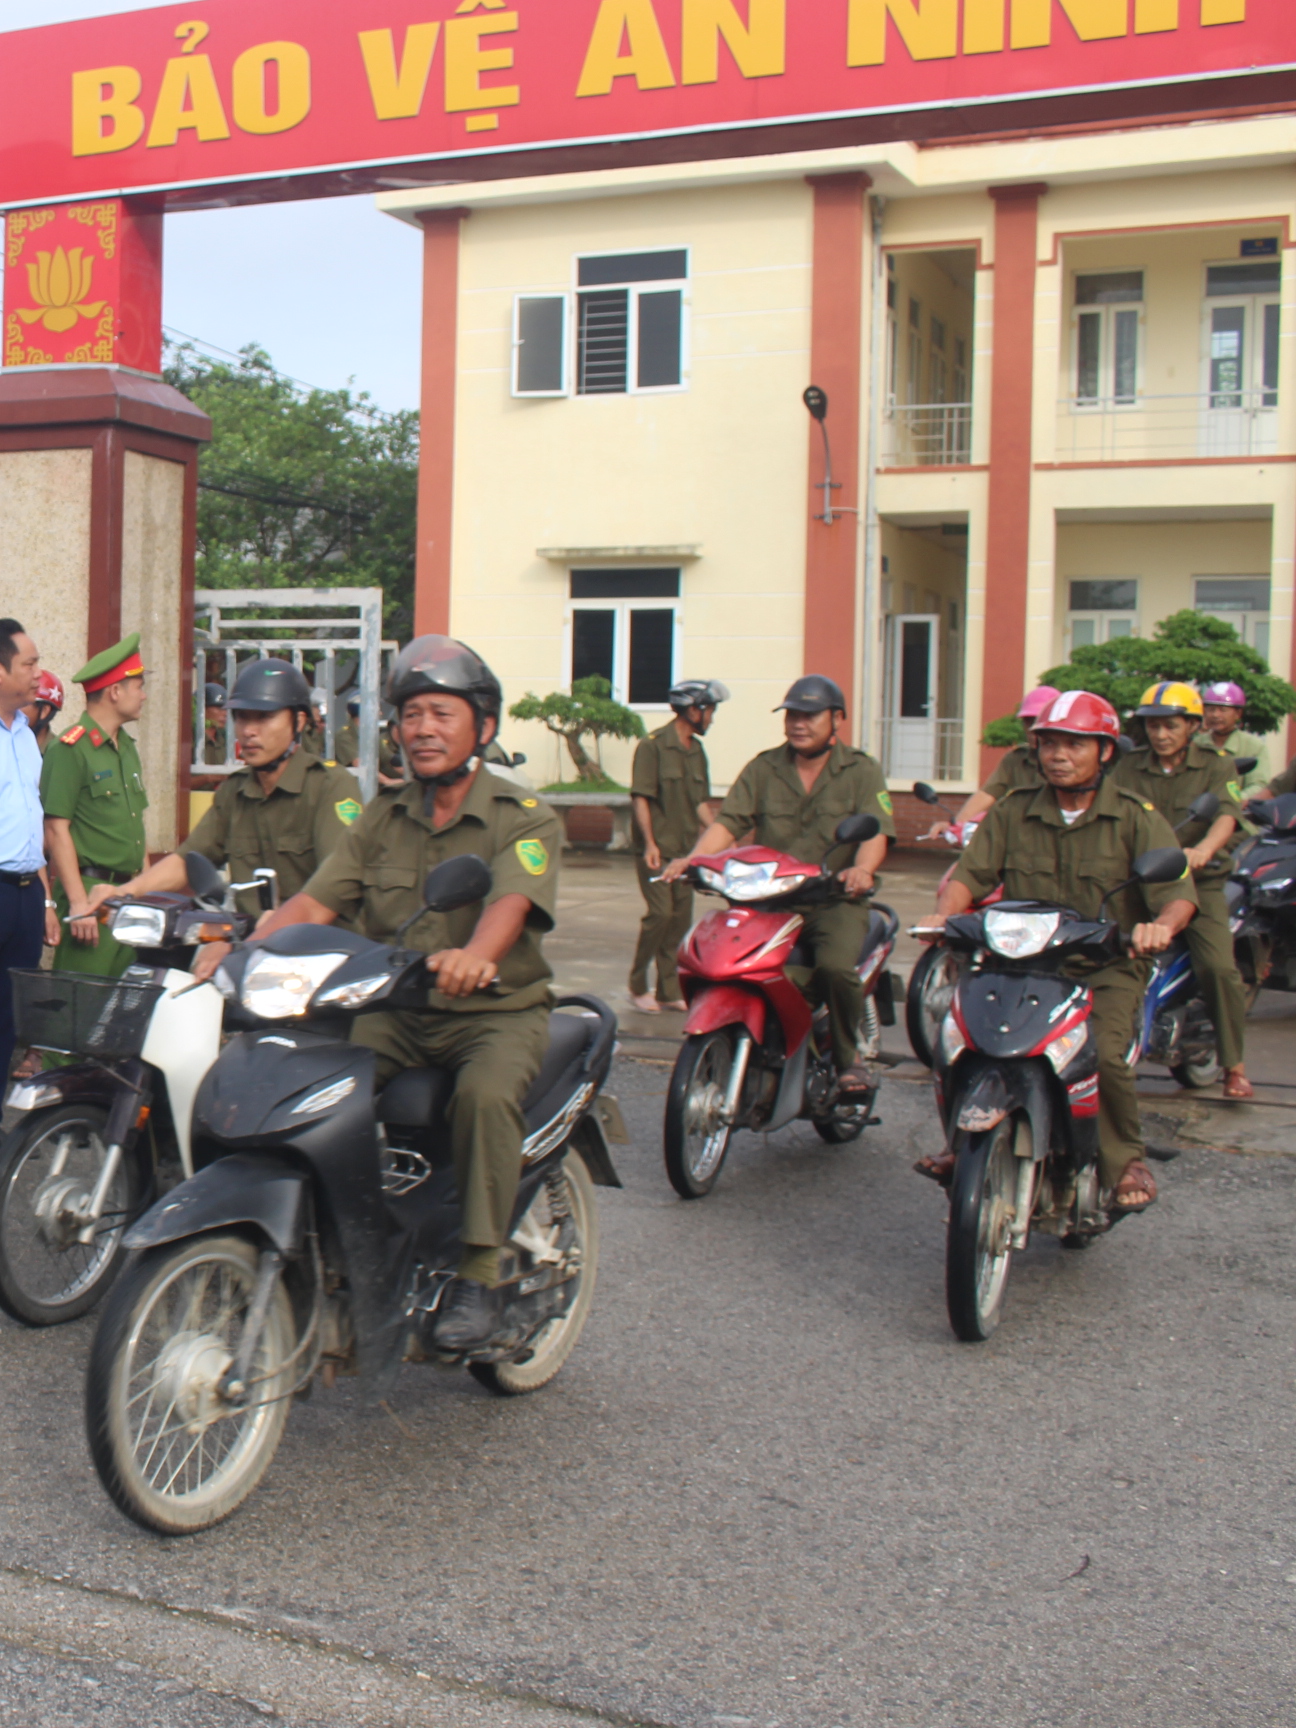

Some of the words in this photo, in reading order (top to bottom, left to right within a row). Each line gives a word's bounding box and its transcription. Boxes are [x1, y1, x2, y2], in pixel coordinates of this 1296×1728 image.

[72, 20, 311, 157] BẢO
[357, 0, 520, 133] VỆ
[575, 0, 787, 98] AN
[847, 0, 1246, 68] NI
